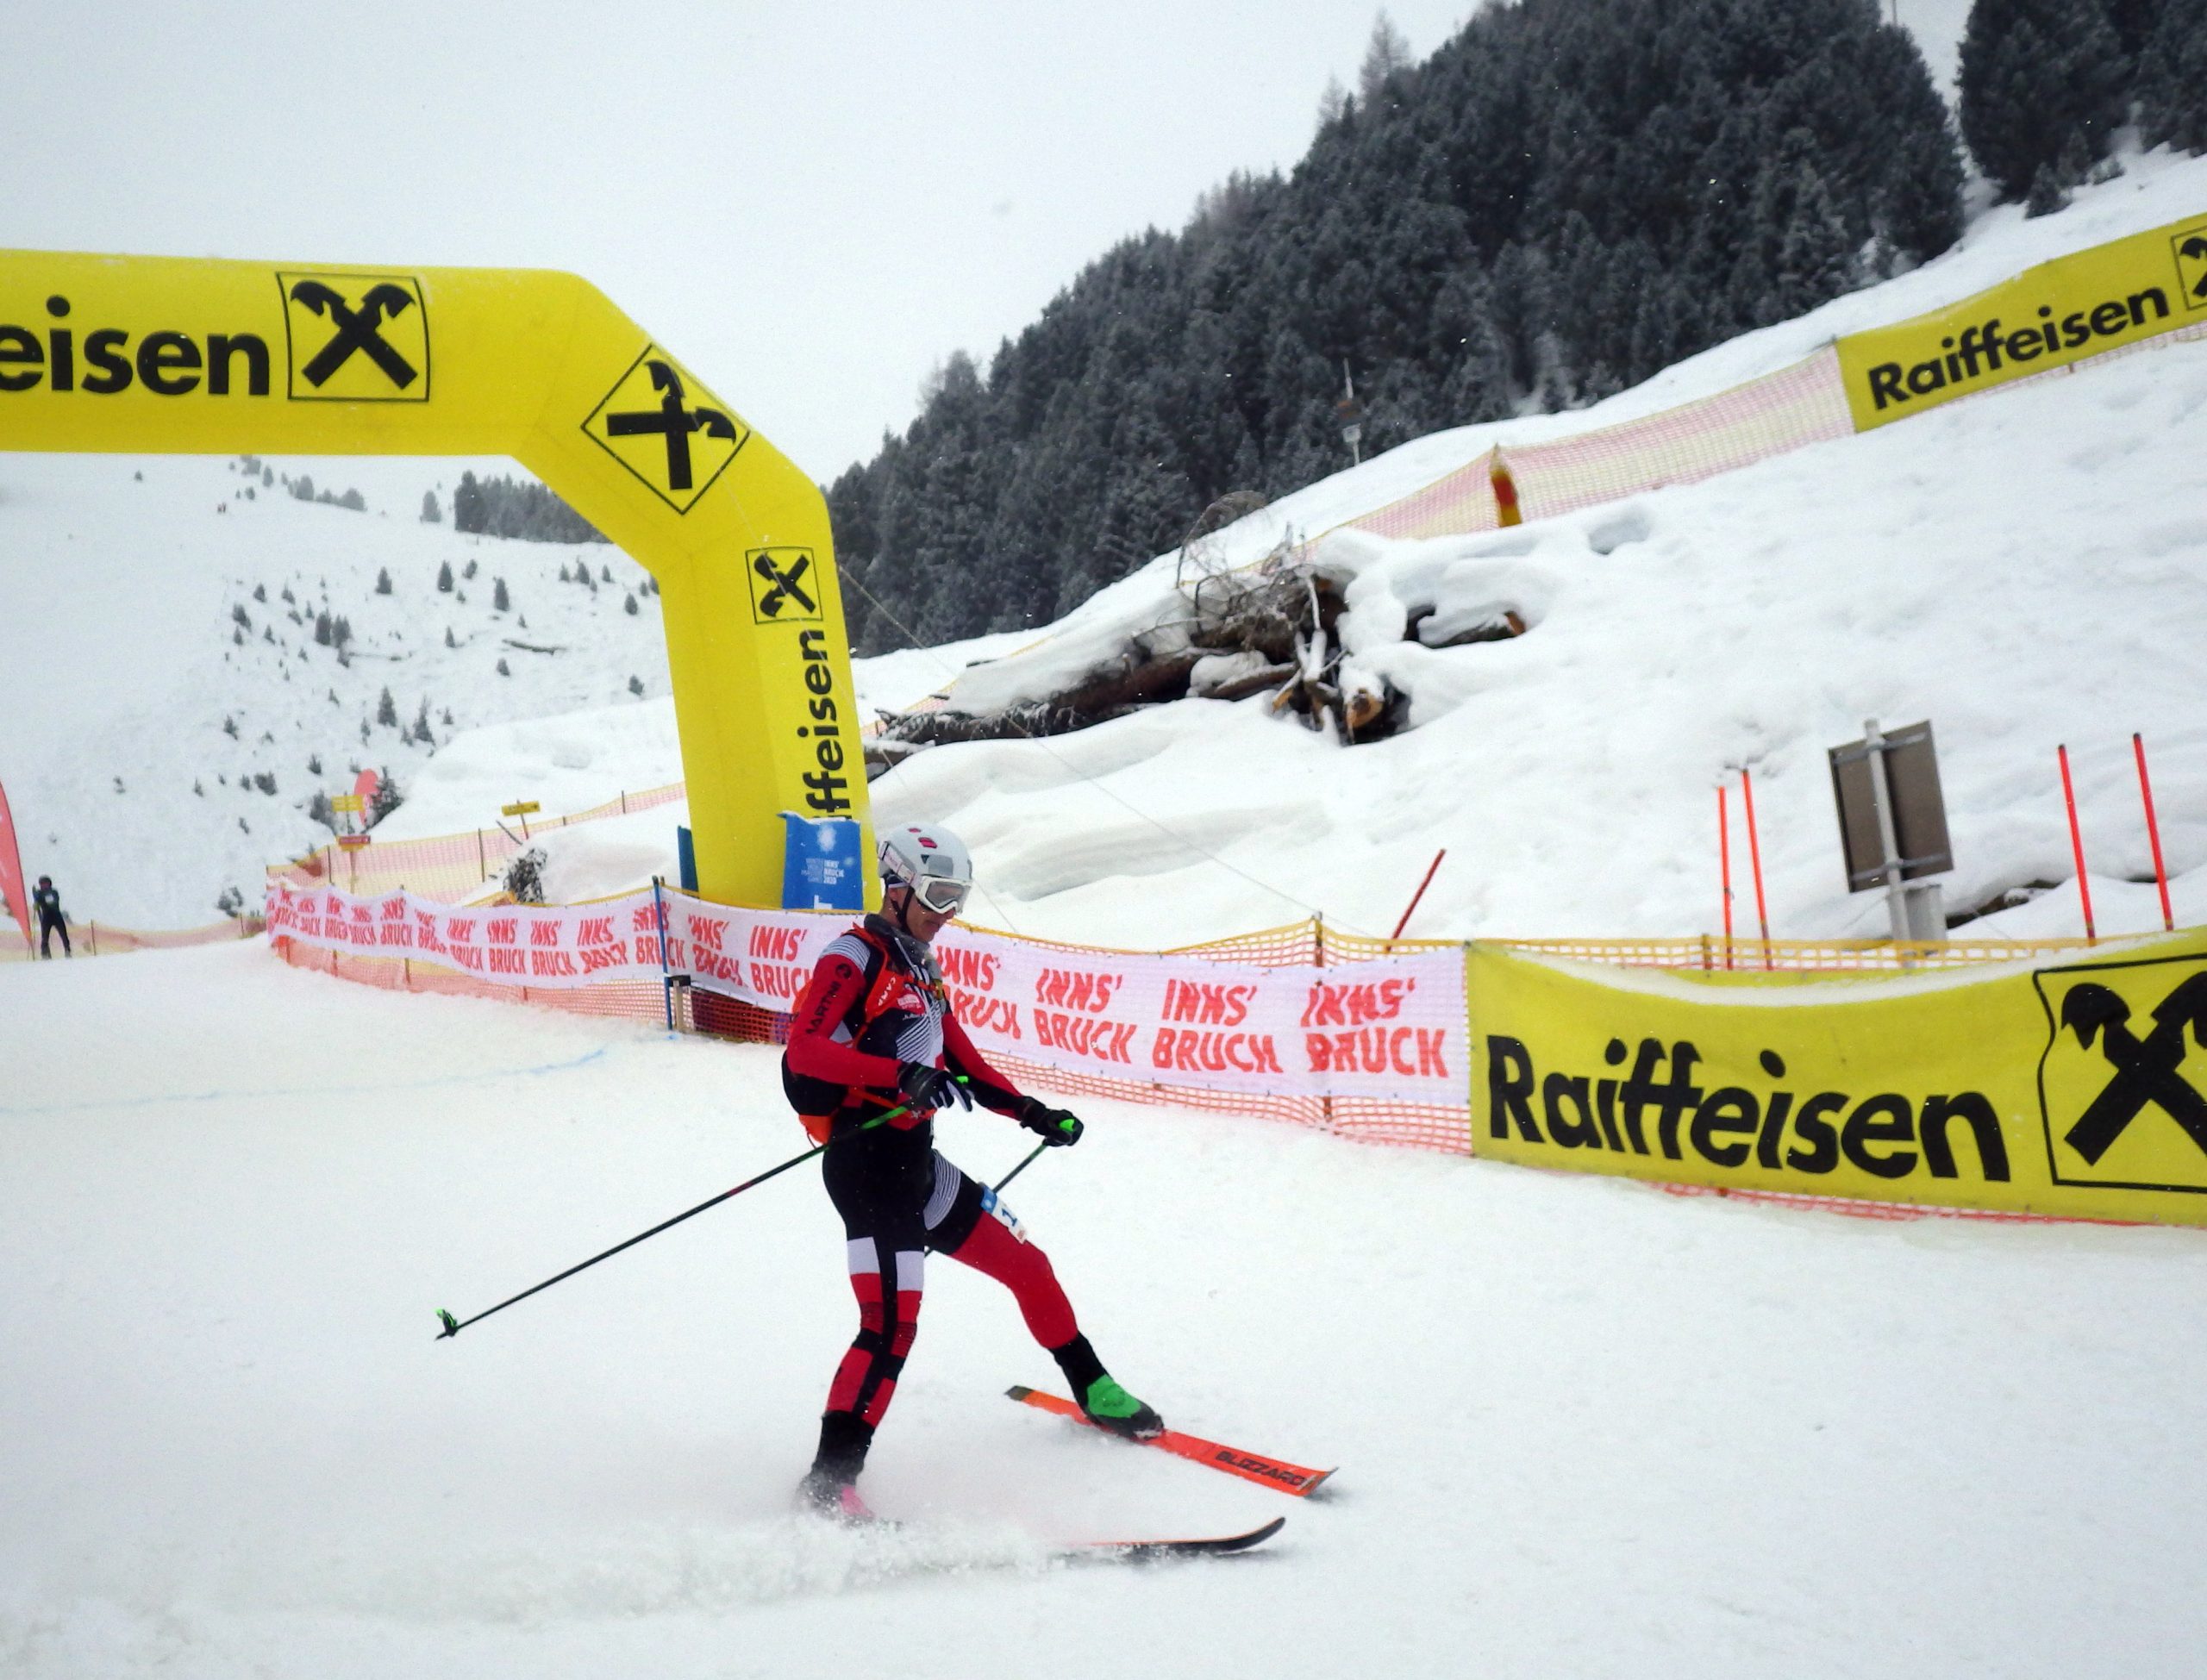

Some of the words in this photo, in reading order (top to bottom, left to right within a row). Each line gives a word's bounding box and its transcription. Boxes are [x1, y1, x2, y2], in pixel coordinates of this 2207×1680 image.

[1868, 288, 2169, 409] Raiffeisen
[798, 629, 850, 819] ffeisen
[749, 925, 808, 962] INNS'
[1036, 968, 1122, 1013] INNS'
[1161, 979, 1257, 1026] INNS'
[1301, 977, 1416, 1027] INNS'
[1035, 1009, 1137, 1064] BRUCK
[1153, 1027, 1283, 1073] BRUCK
[1308, 1027, 1448, 1078] BRUCK
[1485, 1034, 2010, 1183] Raiffeisen
